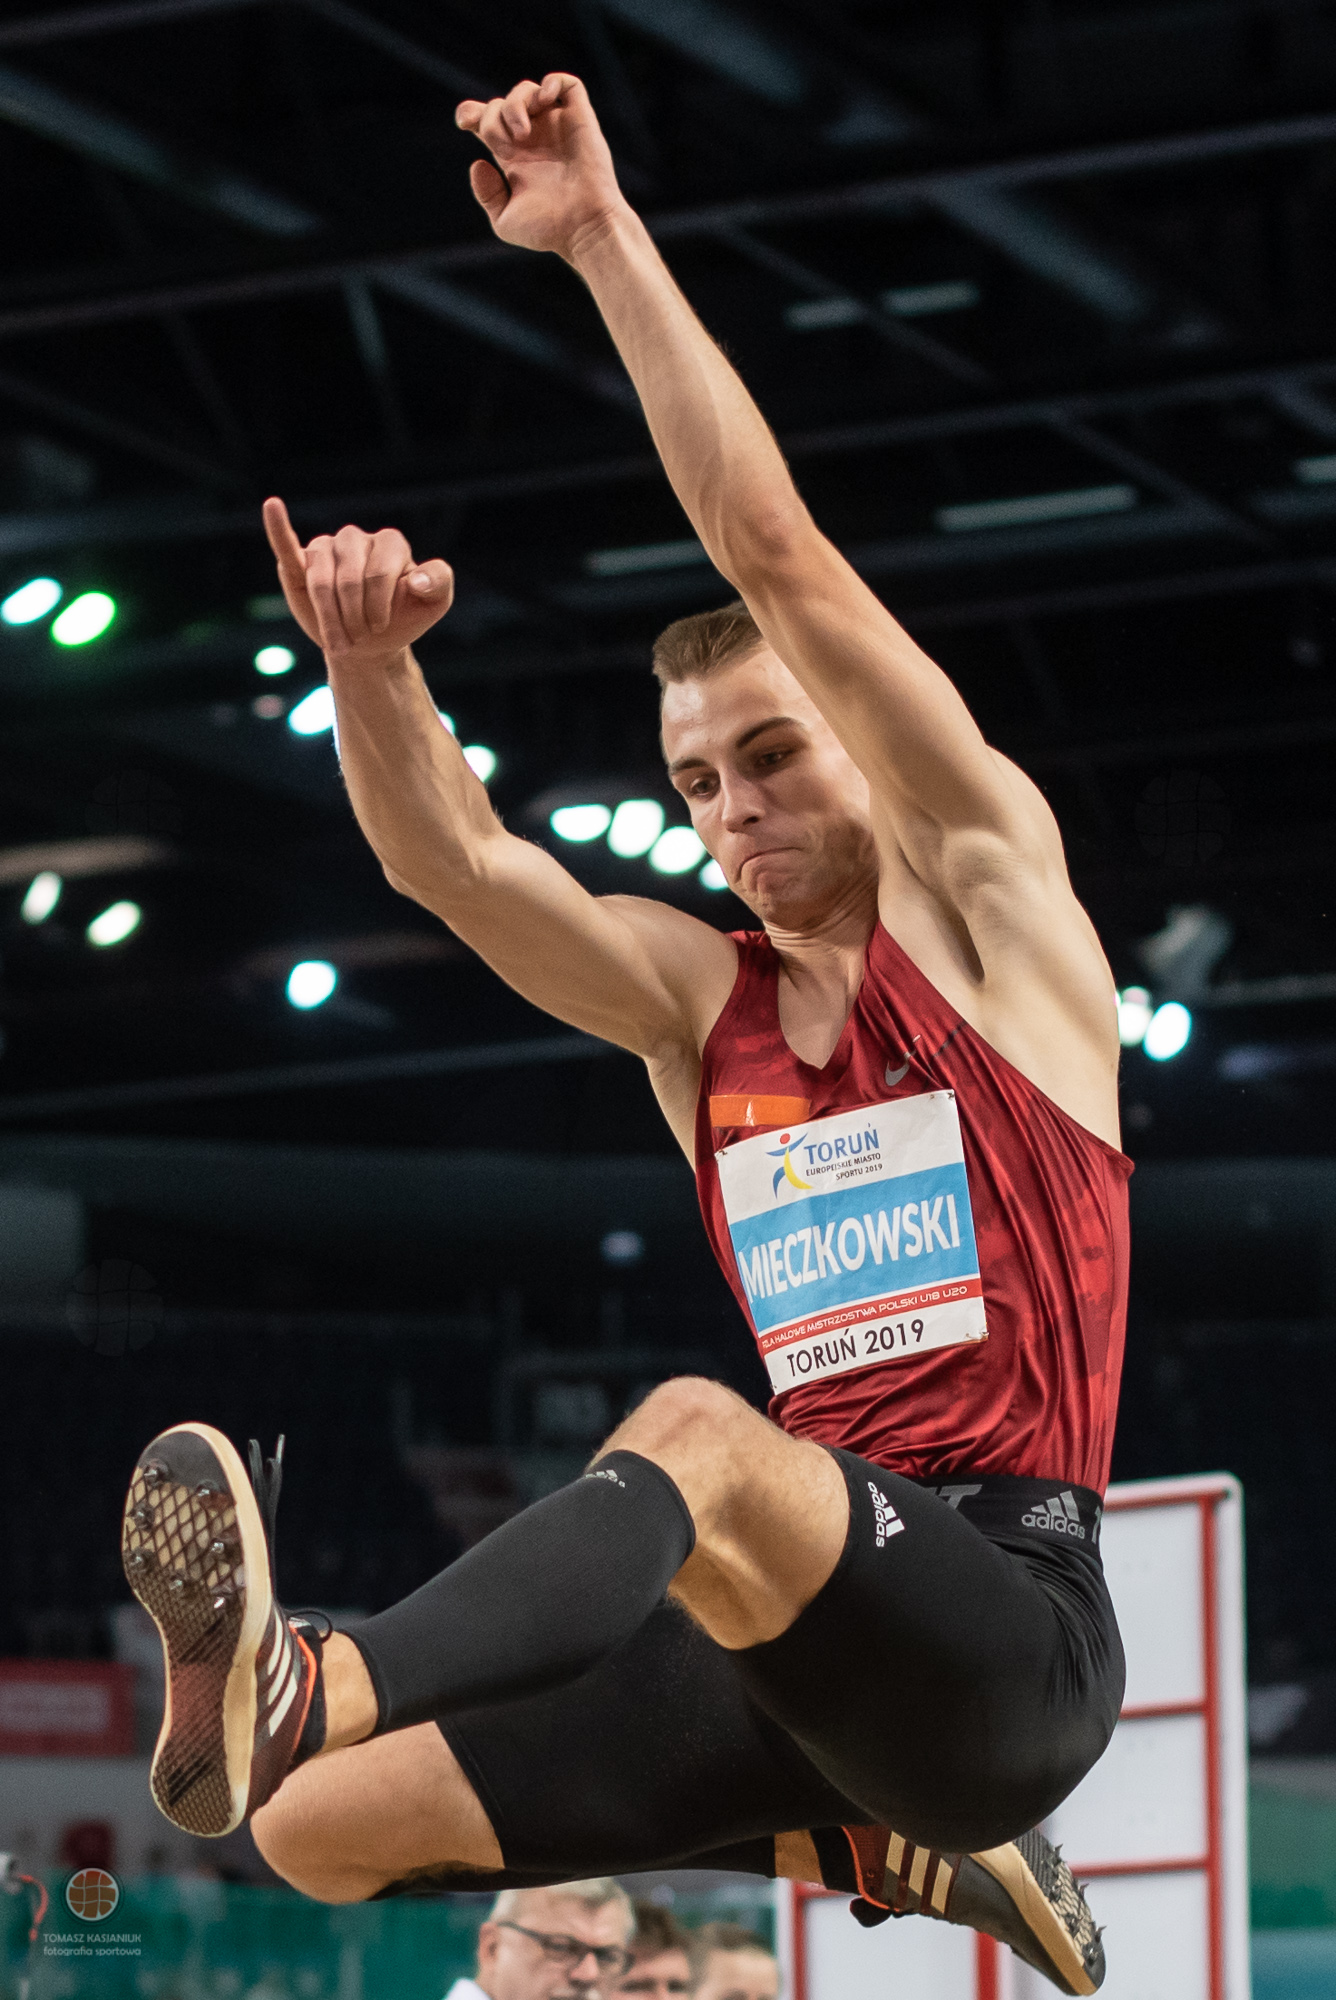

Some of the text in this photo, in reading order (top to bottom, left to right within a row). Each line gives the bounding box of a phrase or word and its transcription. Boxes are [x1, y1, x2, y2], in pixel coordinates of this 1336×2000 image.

[804, 1122, 879, 1165] TORUŃ
[854, 1152, 881, 1165] MIASTO
[836, 1163, 883, 1180] SPORTU 2019
[738, 1194, 961, 1304] MIECZKOWSKI
[775, 1325, 806, 1344] HALOWE
[807, 1306, 877, 1333] MISTRZOSTWA
[879, 1296, 918, 1313] POLSKI
[920, 1291, 941, 1303] U18
[942, 1285, 968, 1298] U20
[787, 1319, 924, 1377] TORUŃ 2019
[868, 1481, 886, 1547] adidas
[1021, 1513, 1085, 1539] adidas
